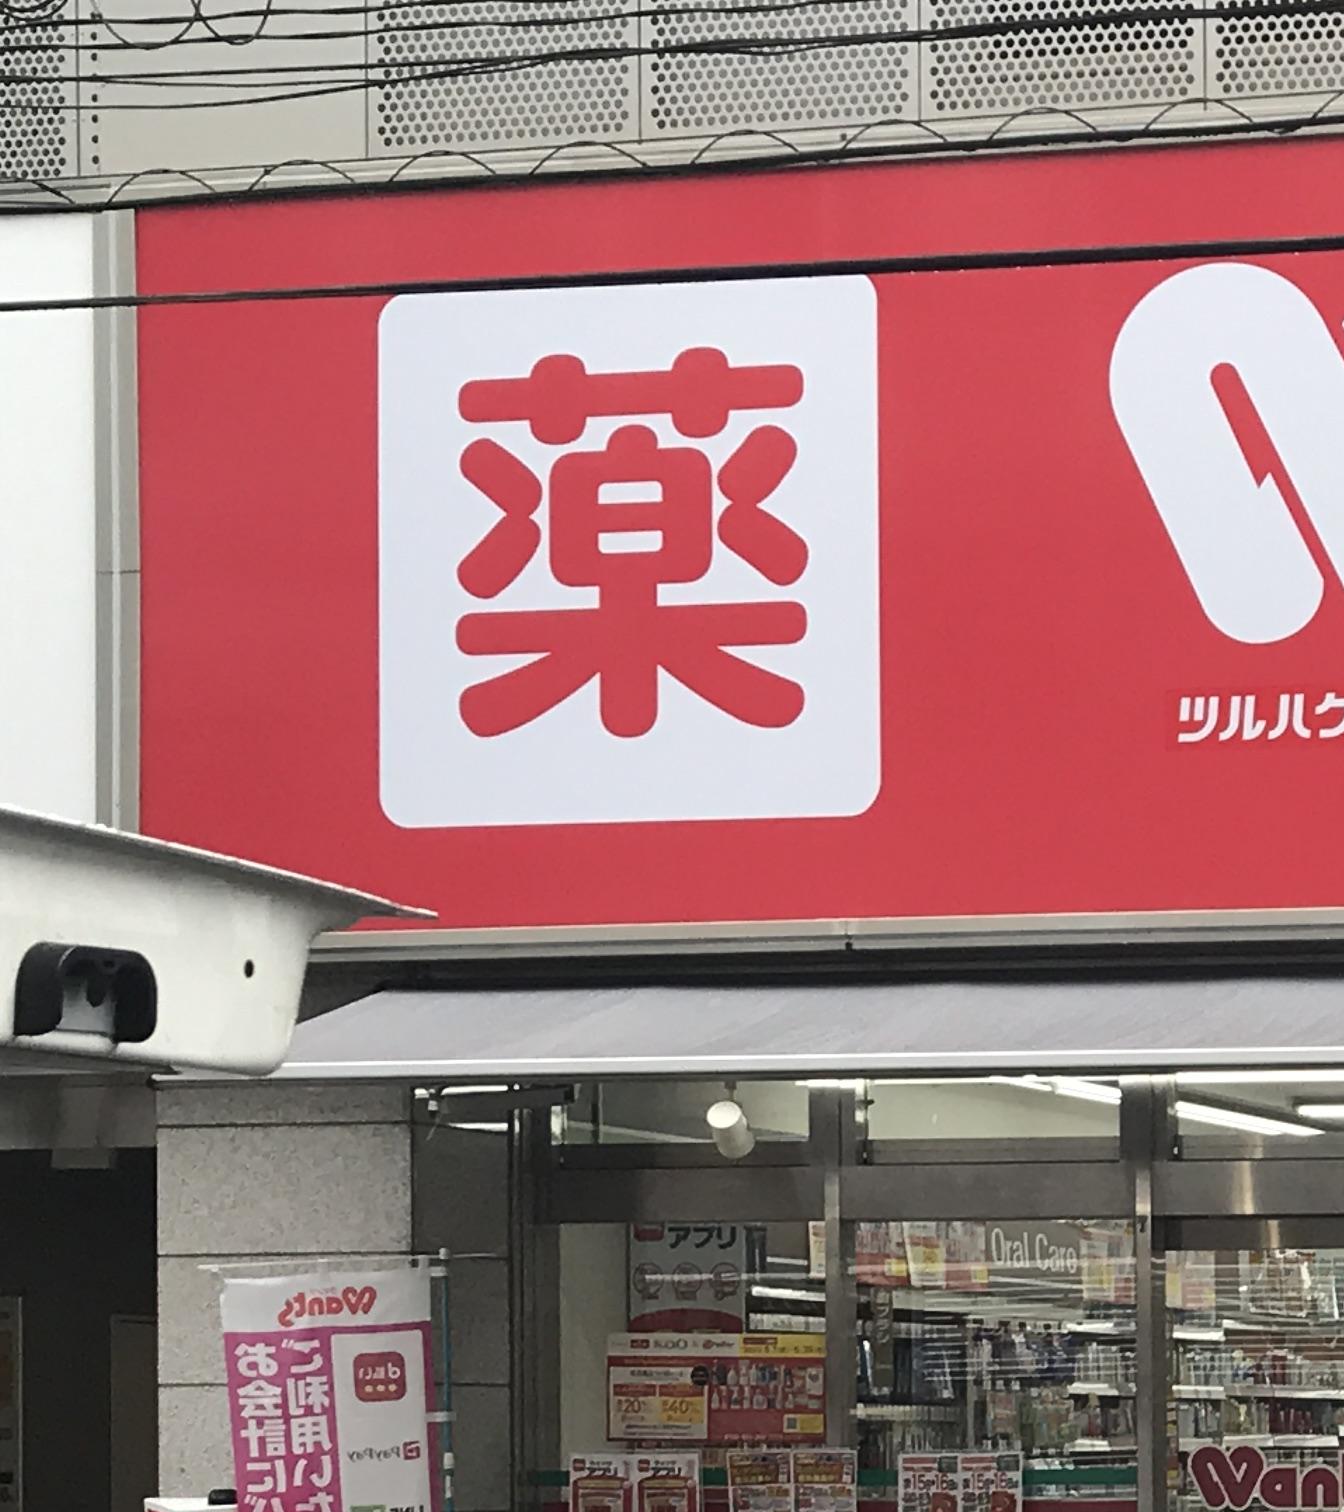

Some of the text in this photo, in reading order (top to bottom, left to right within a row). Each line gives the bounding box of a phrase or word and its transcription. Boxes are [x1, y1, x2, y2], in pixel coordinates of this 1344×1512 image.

[454, 344, 810, 739] 薬
[667, 1226, 737, 1249] アプリ
[991, 1227, 1078, 1273] Oral Care
